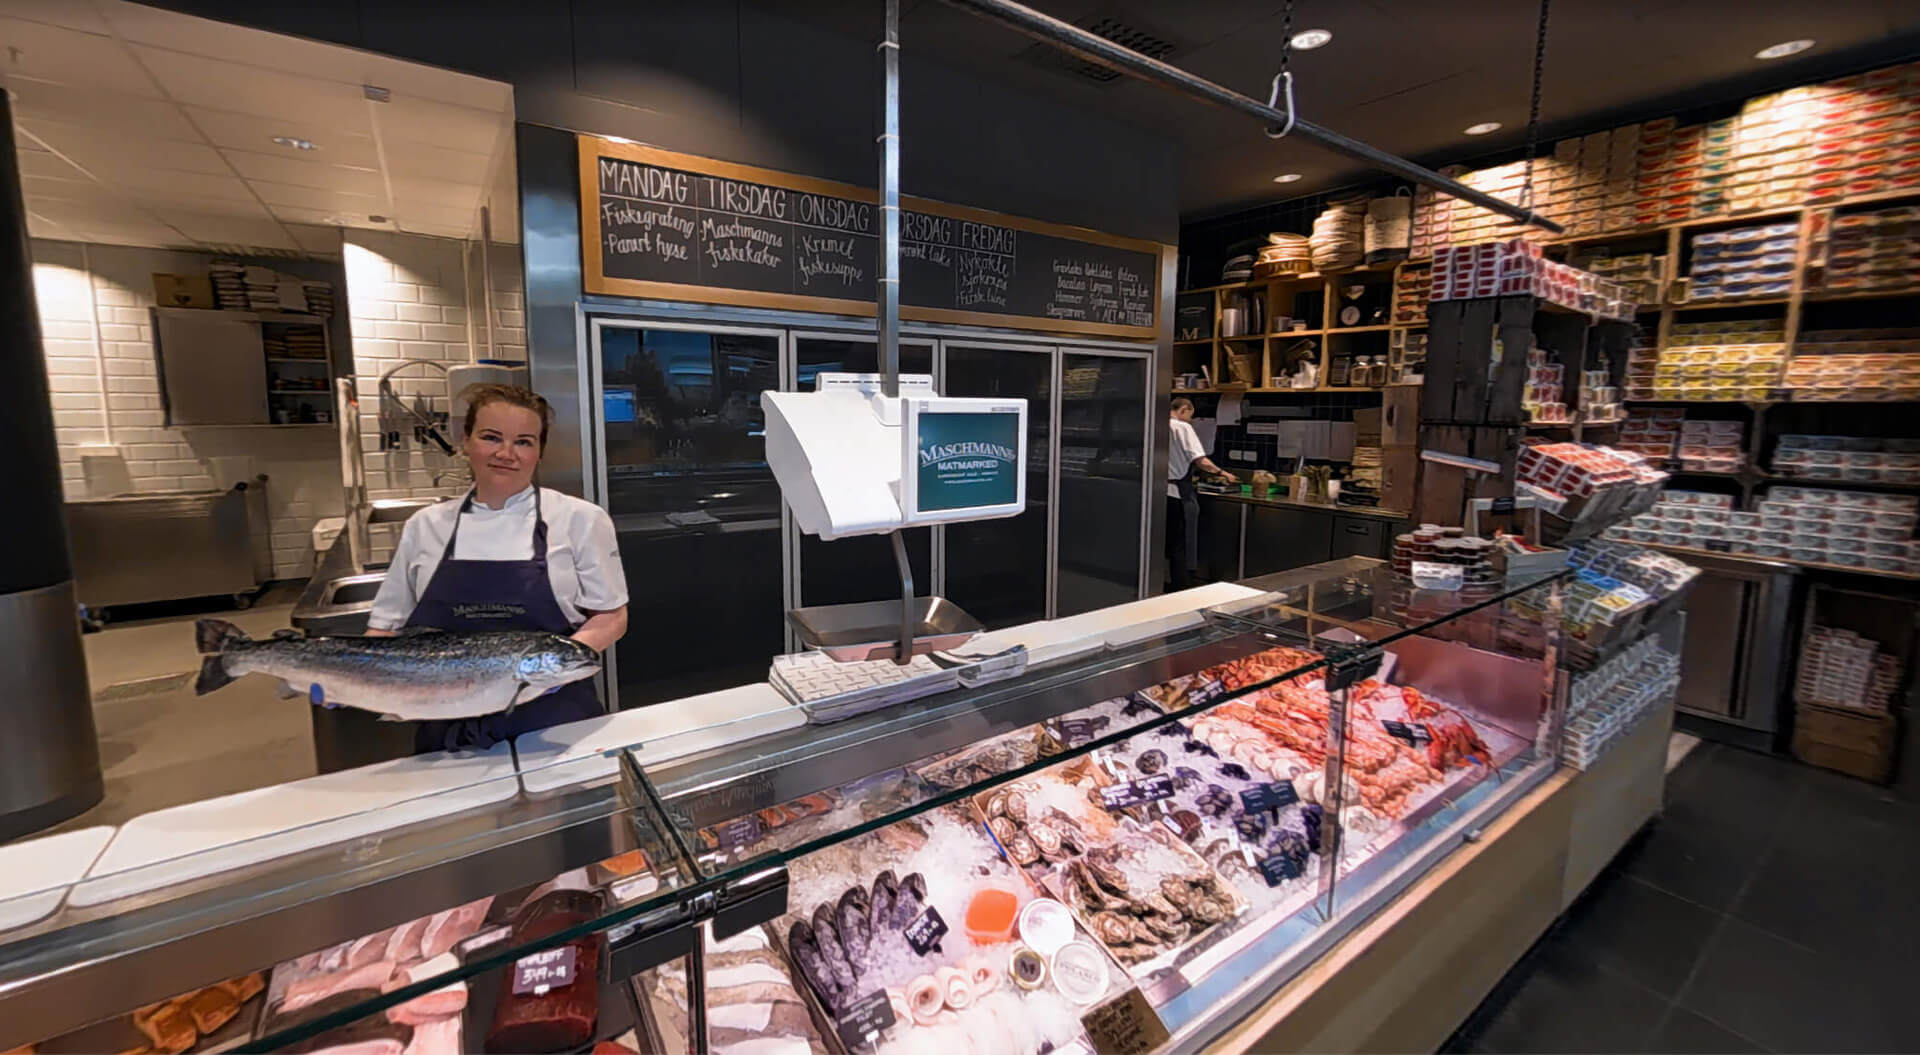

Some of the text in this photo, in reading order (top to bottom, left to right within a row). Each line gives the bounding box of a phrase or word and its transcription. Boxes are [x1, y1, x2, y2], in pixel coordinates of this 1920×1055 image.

[600, 159, 688, 203] MANDAG
[703, 177, 786, 218] TIRSDAG
[800, 194, 869, 231] ONSDAG
[702, 216, 783, 248] Maschmanns
[962, 222, 1013, 253] FREDAG
